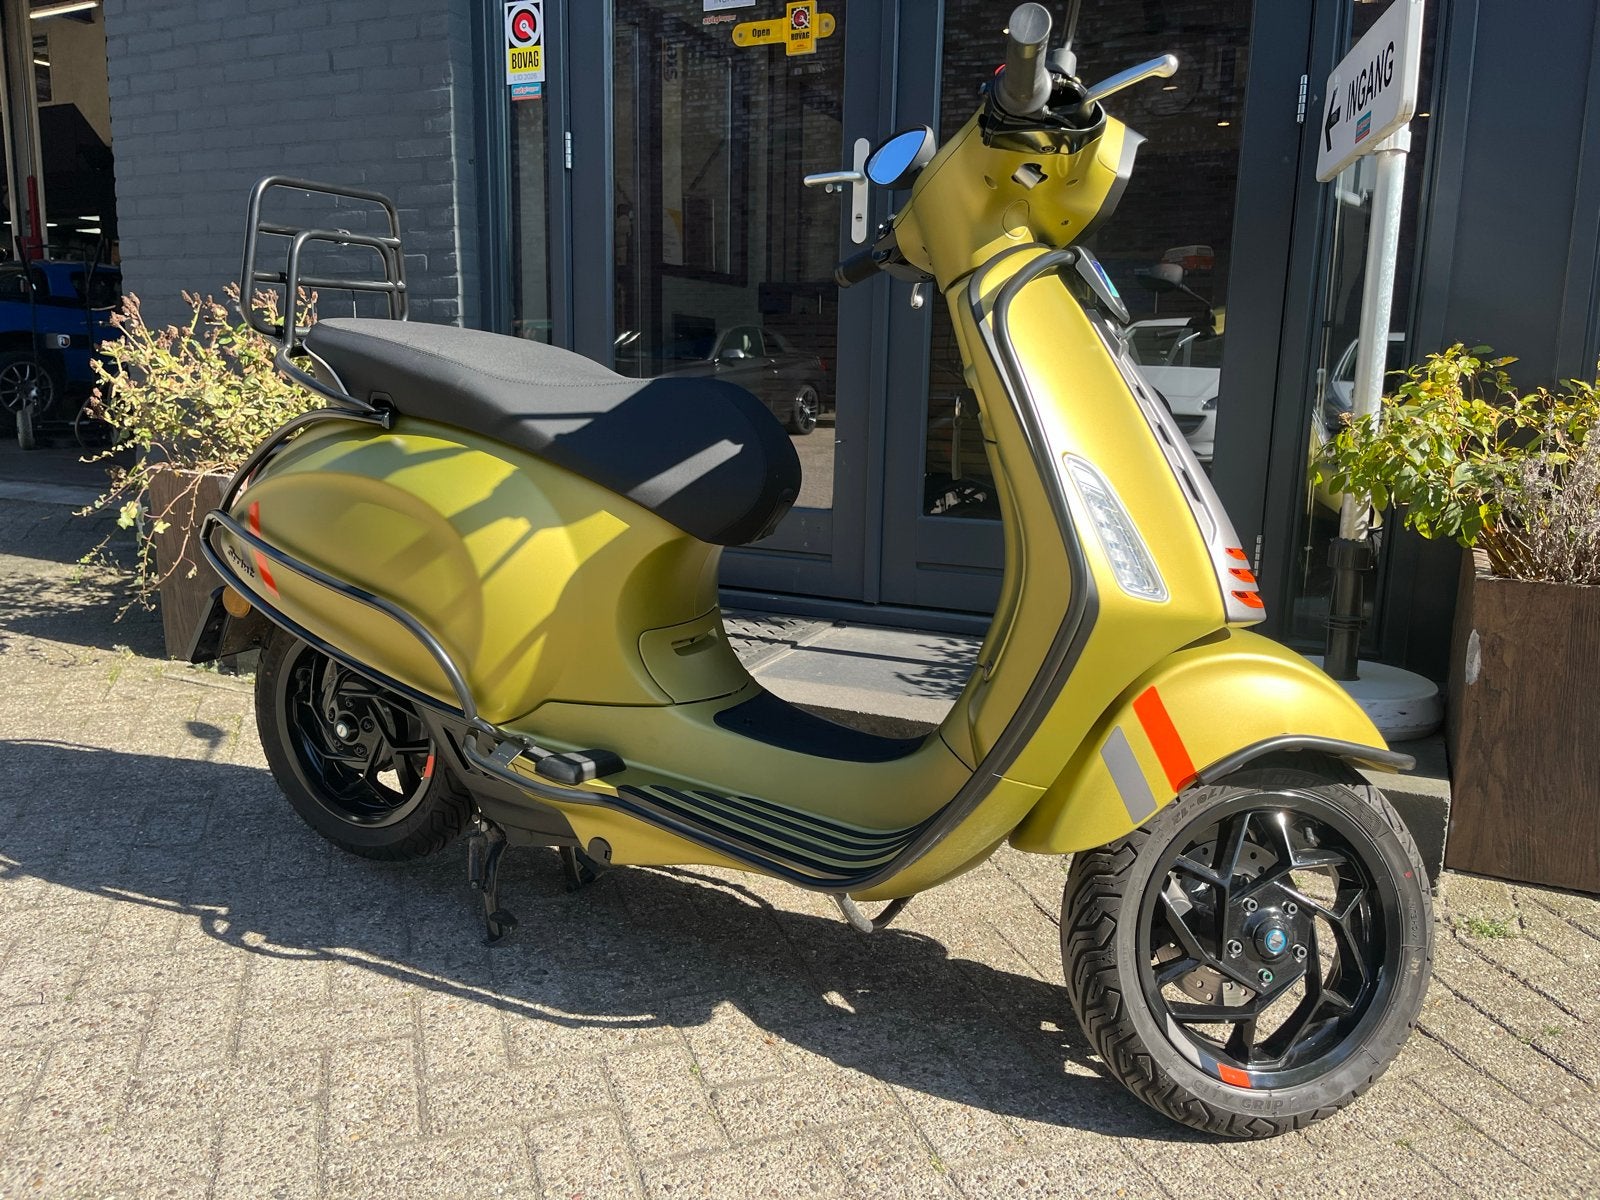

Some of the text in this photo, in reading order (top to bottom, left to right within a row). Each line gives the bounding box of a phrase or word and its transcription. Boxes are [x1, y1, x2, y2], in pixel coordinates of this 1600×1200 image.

[752, 28, 770, 38] Open
[791, 31, 810, 41] BOVAG
[511, 50, 539, 70] BOVAG
[1345, 41, 1395, 123] INGANG
[1192, 1078, 1284, 1112] CITY GRIP
